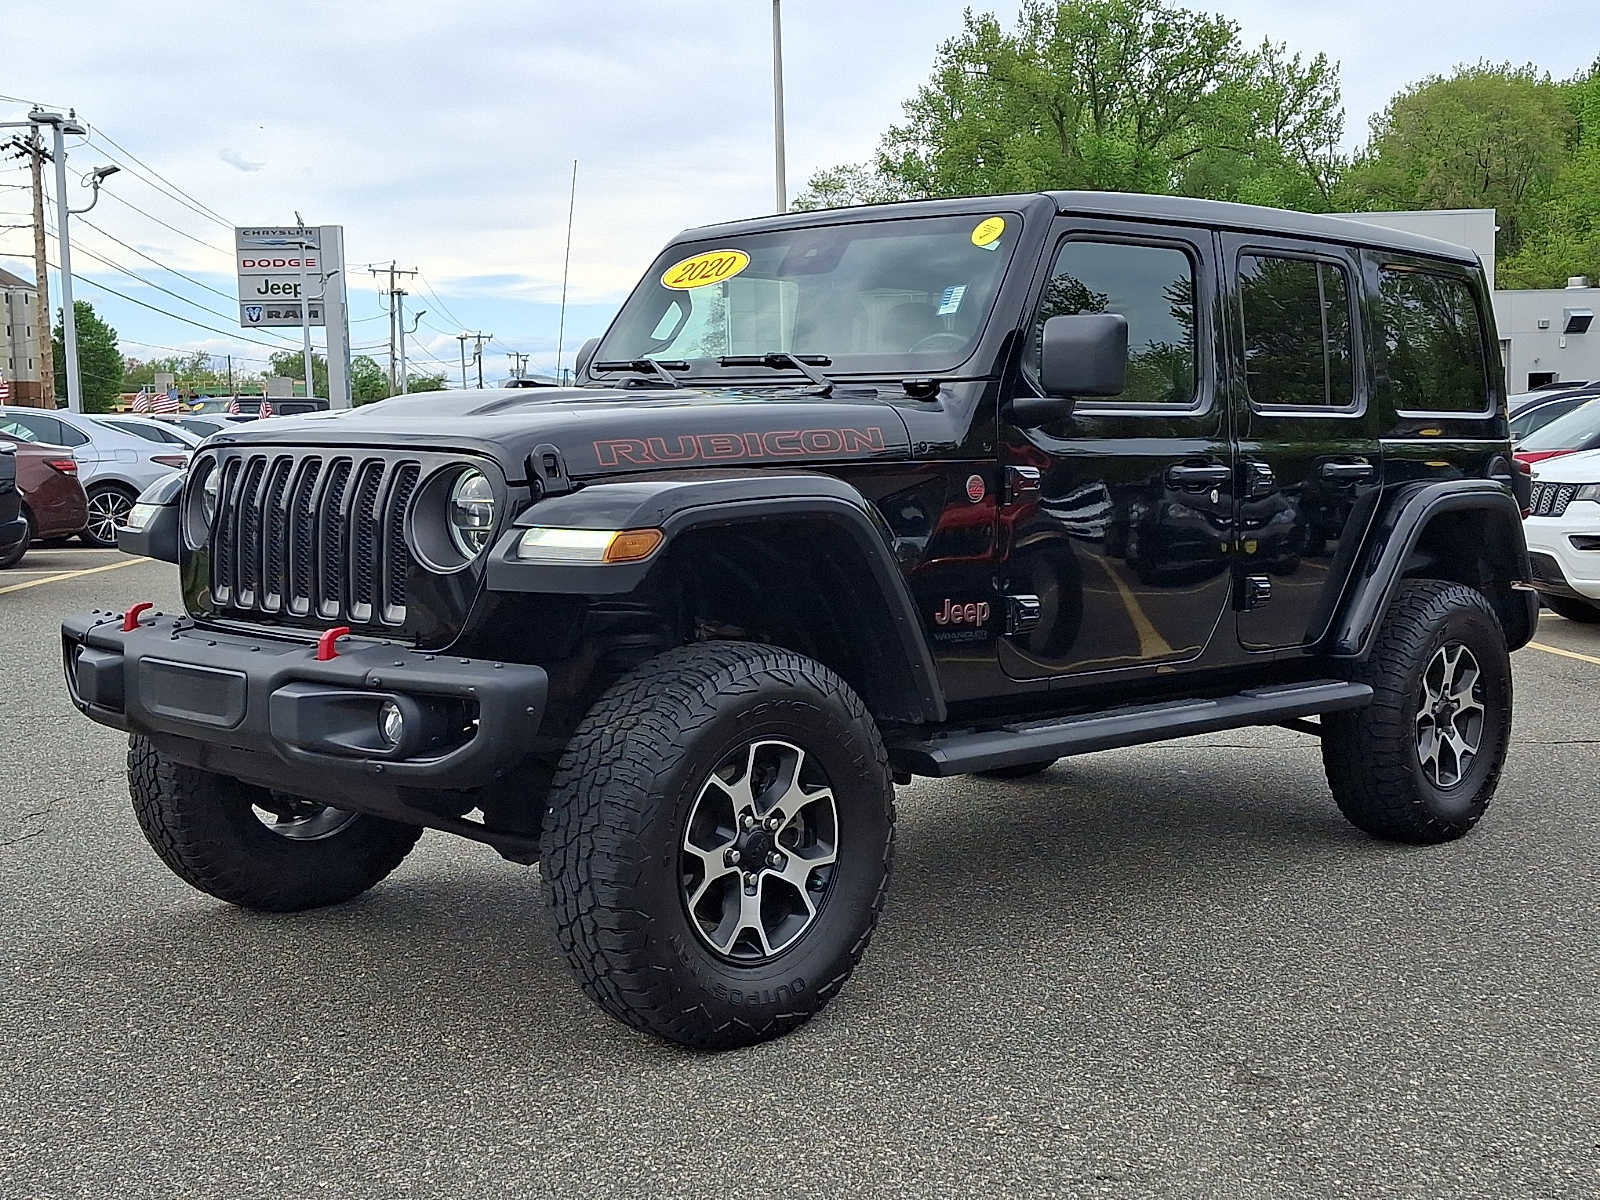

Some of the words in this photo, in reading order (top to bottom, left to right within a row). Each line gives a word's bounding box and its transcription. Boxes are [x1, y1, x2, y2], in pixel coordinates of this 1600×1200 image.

[242, 259, 317, 268] DODGE
[672, 256, 736, 283] 2020
[267, 310, 319, 319] RAM
[593, 427, 885, 466] RUBICON
[935, 599, 990, 627] Jeep
